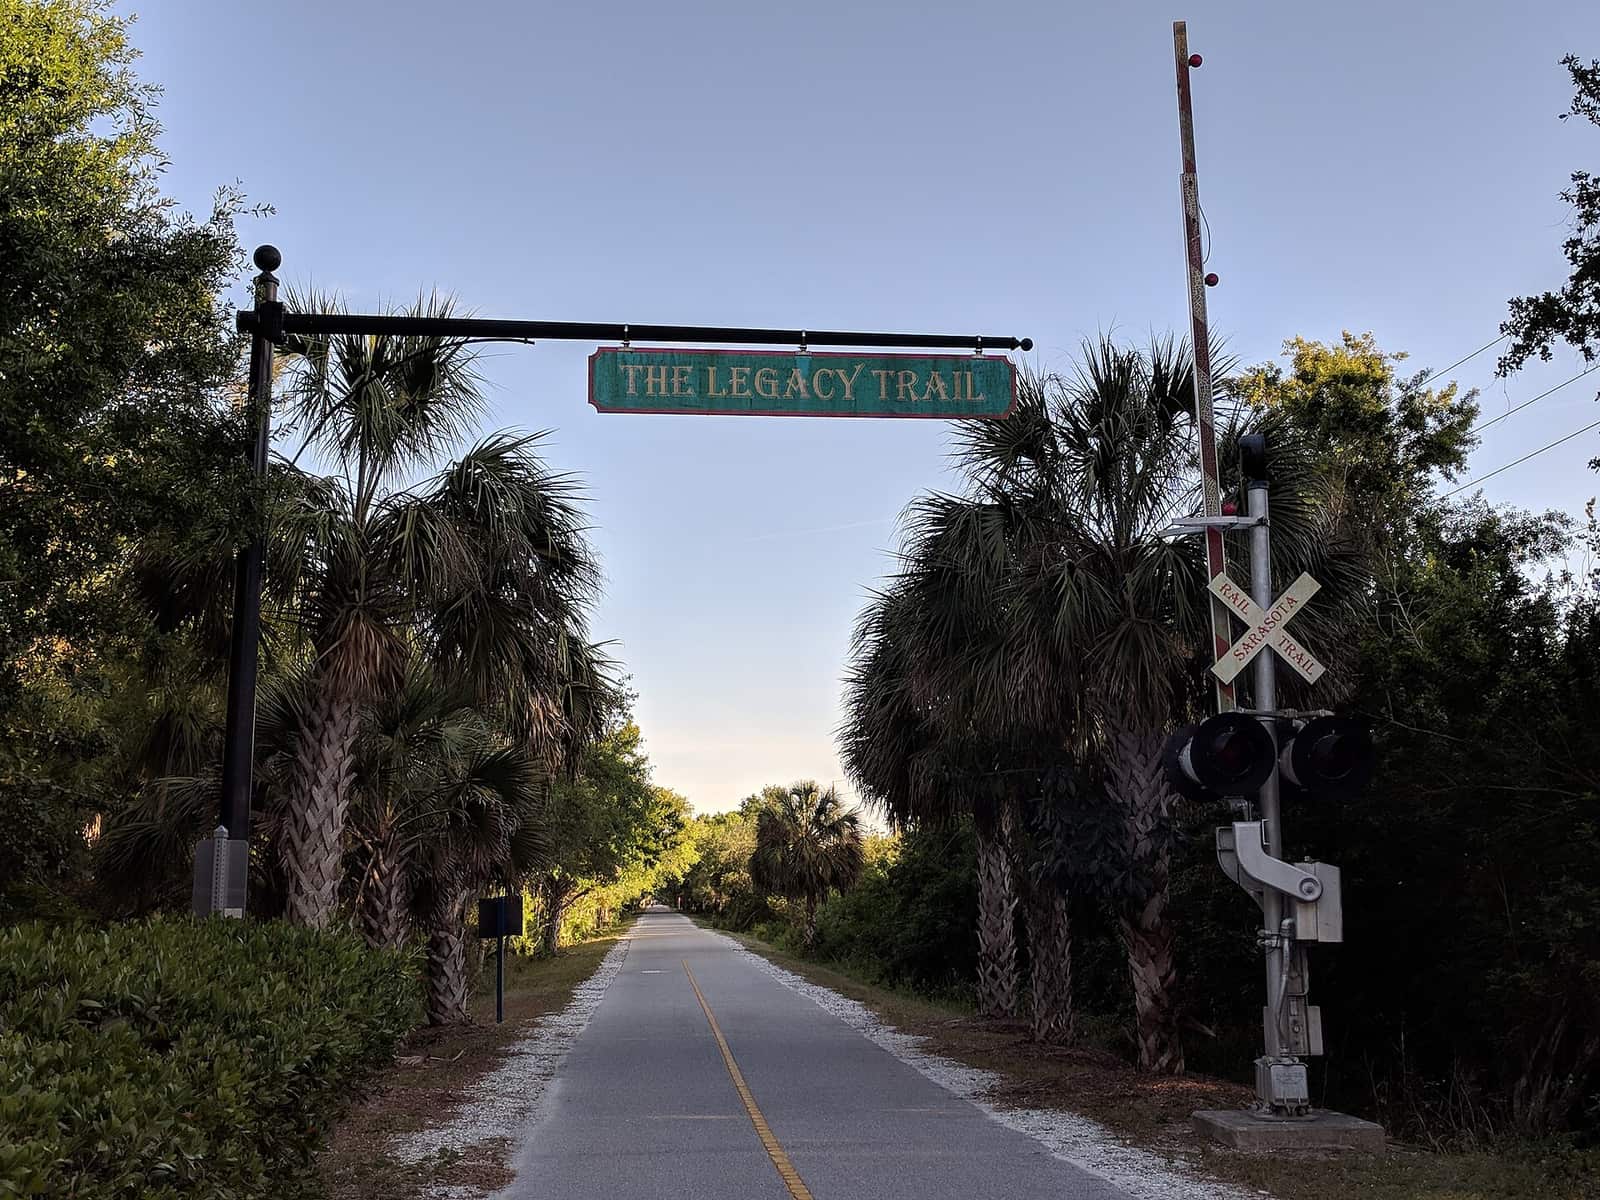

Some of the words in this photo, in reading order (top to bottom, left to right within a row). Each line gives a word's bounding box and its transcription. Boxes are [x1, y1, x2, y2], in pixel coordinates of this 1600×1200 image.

[620, 365, 695, 397] THE
[707, 363, 865, 400] LEGACY
[872, 369, 987, 402] TRAIL
[1220, 583, 1250, 615] RAIL
[1234, 595, 1298, 661] SARASOTA
[1278, 635, 1315, 676] TRAIL
